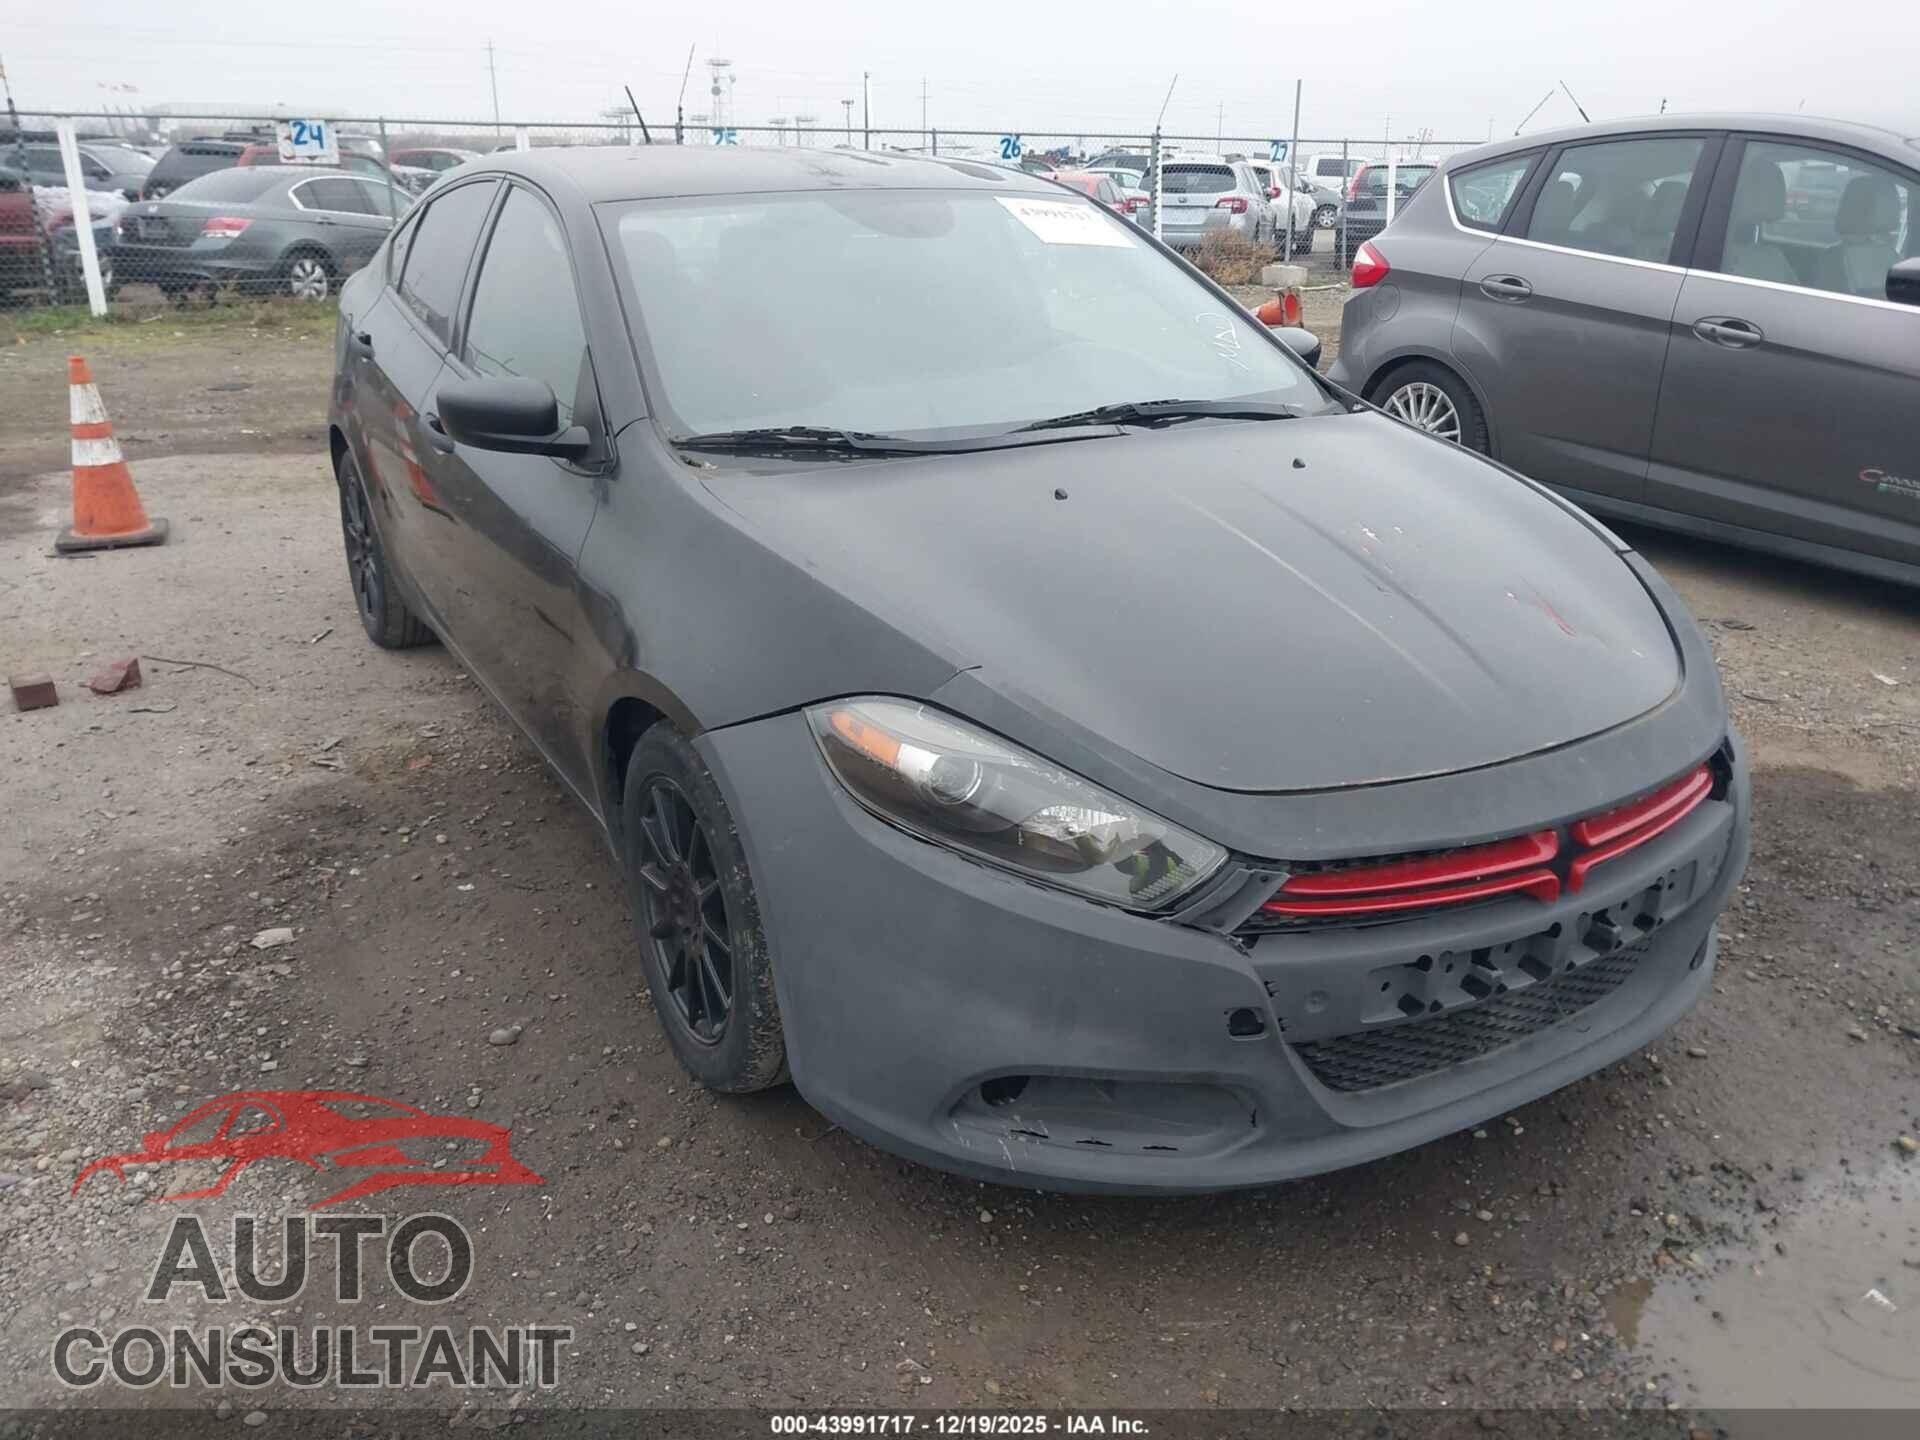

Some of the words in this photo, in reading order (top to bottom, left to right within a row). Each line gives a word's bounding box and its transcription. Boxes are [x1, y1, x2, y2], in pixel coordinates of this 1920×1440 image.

[291, 120, 324, 150] 24
[713, 127, 737, 145] 25
[1000, 137, 1021, 159] 26
[1271, 142, 1288, 162] 27
